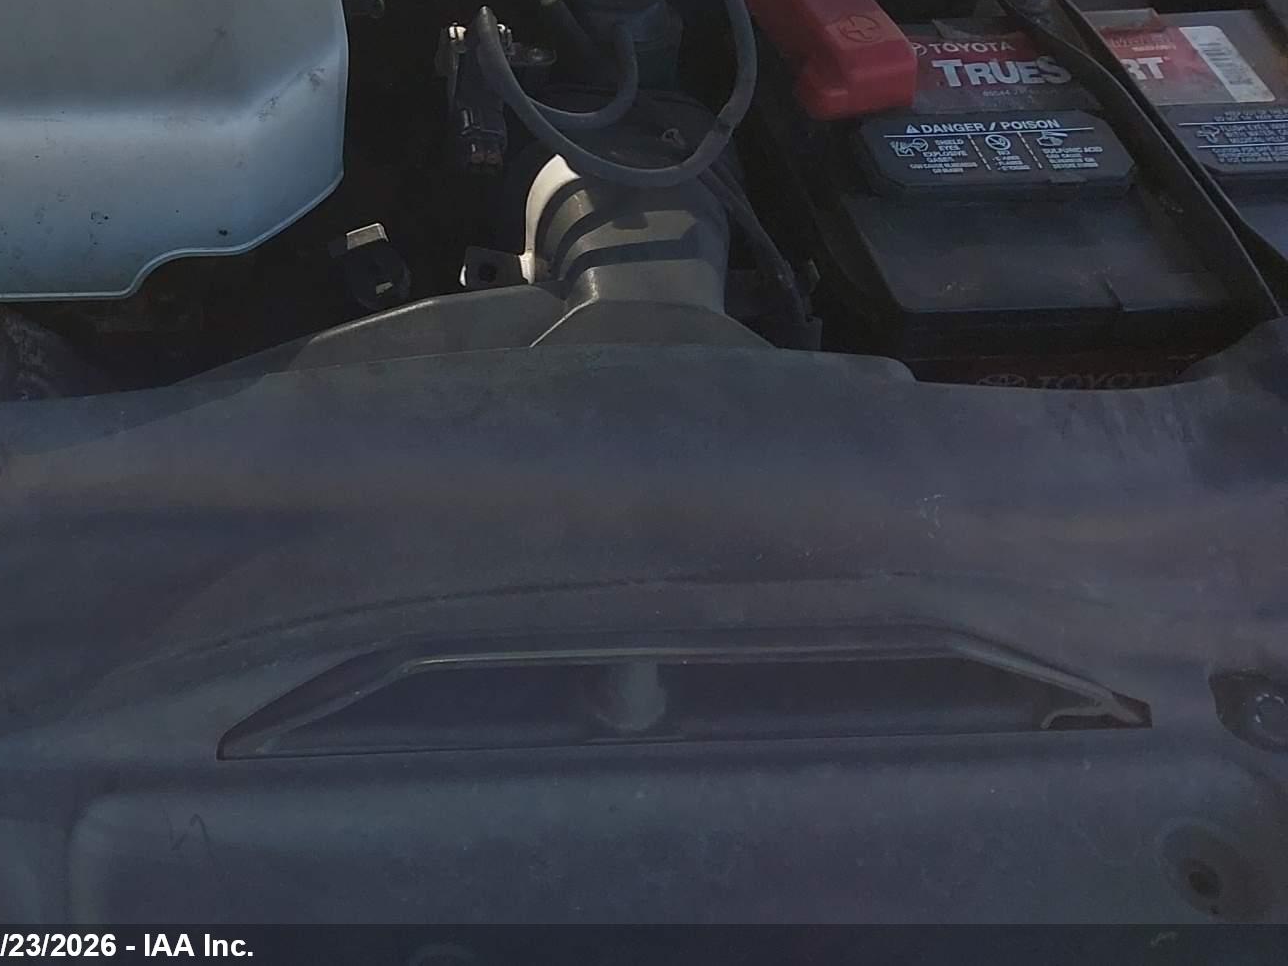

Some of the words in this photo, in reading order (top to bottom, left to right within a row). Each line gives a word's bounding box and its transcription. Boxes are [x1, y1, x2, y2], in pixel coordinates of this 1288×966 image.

[929, 41, 1016, 55] TOYOTA
[920, 122, 987, 134] DANGER
[989, 121, 996, 131] /
[1001, 119, 1060, 131] POISON
